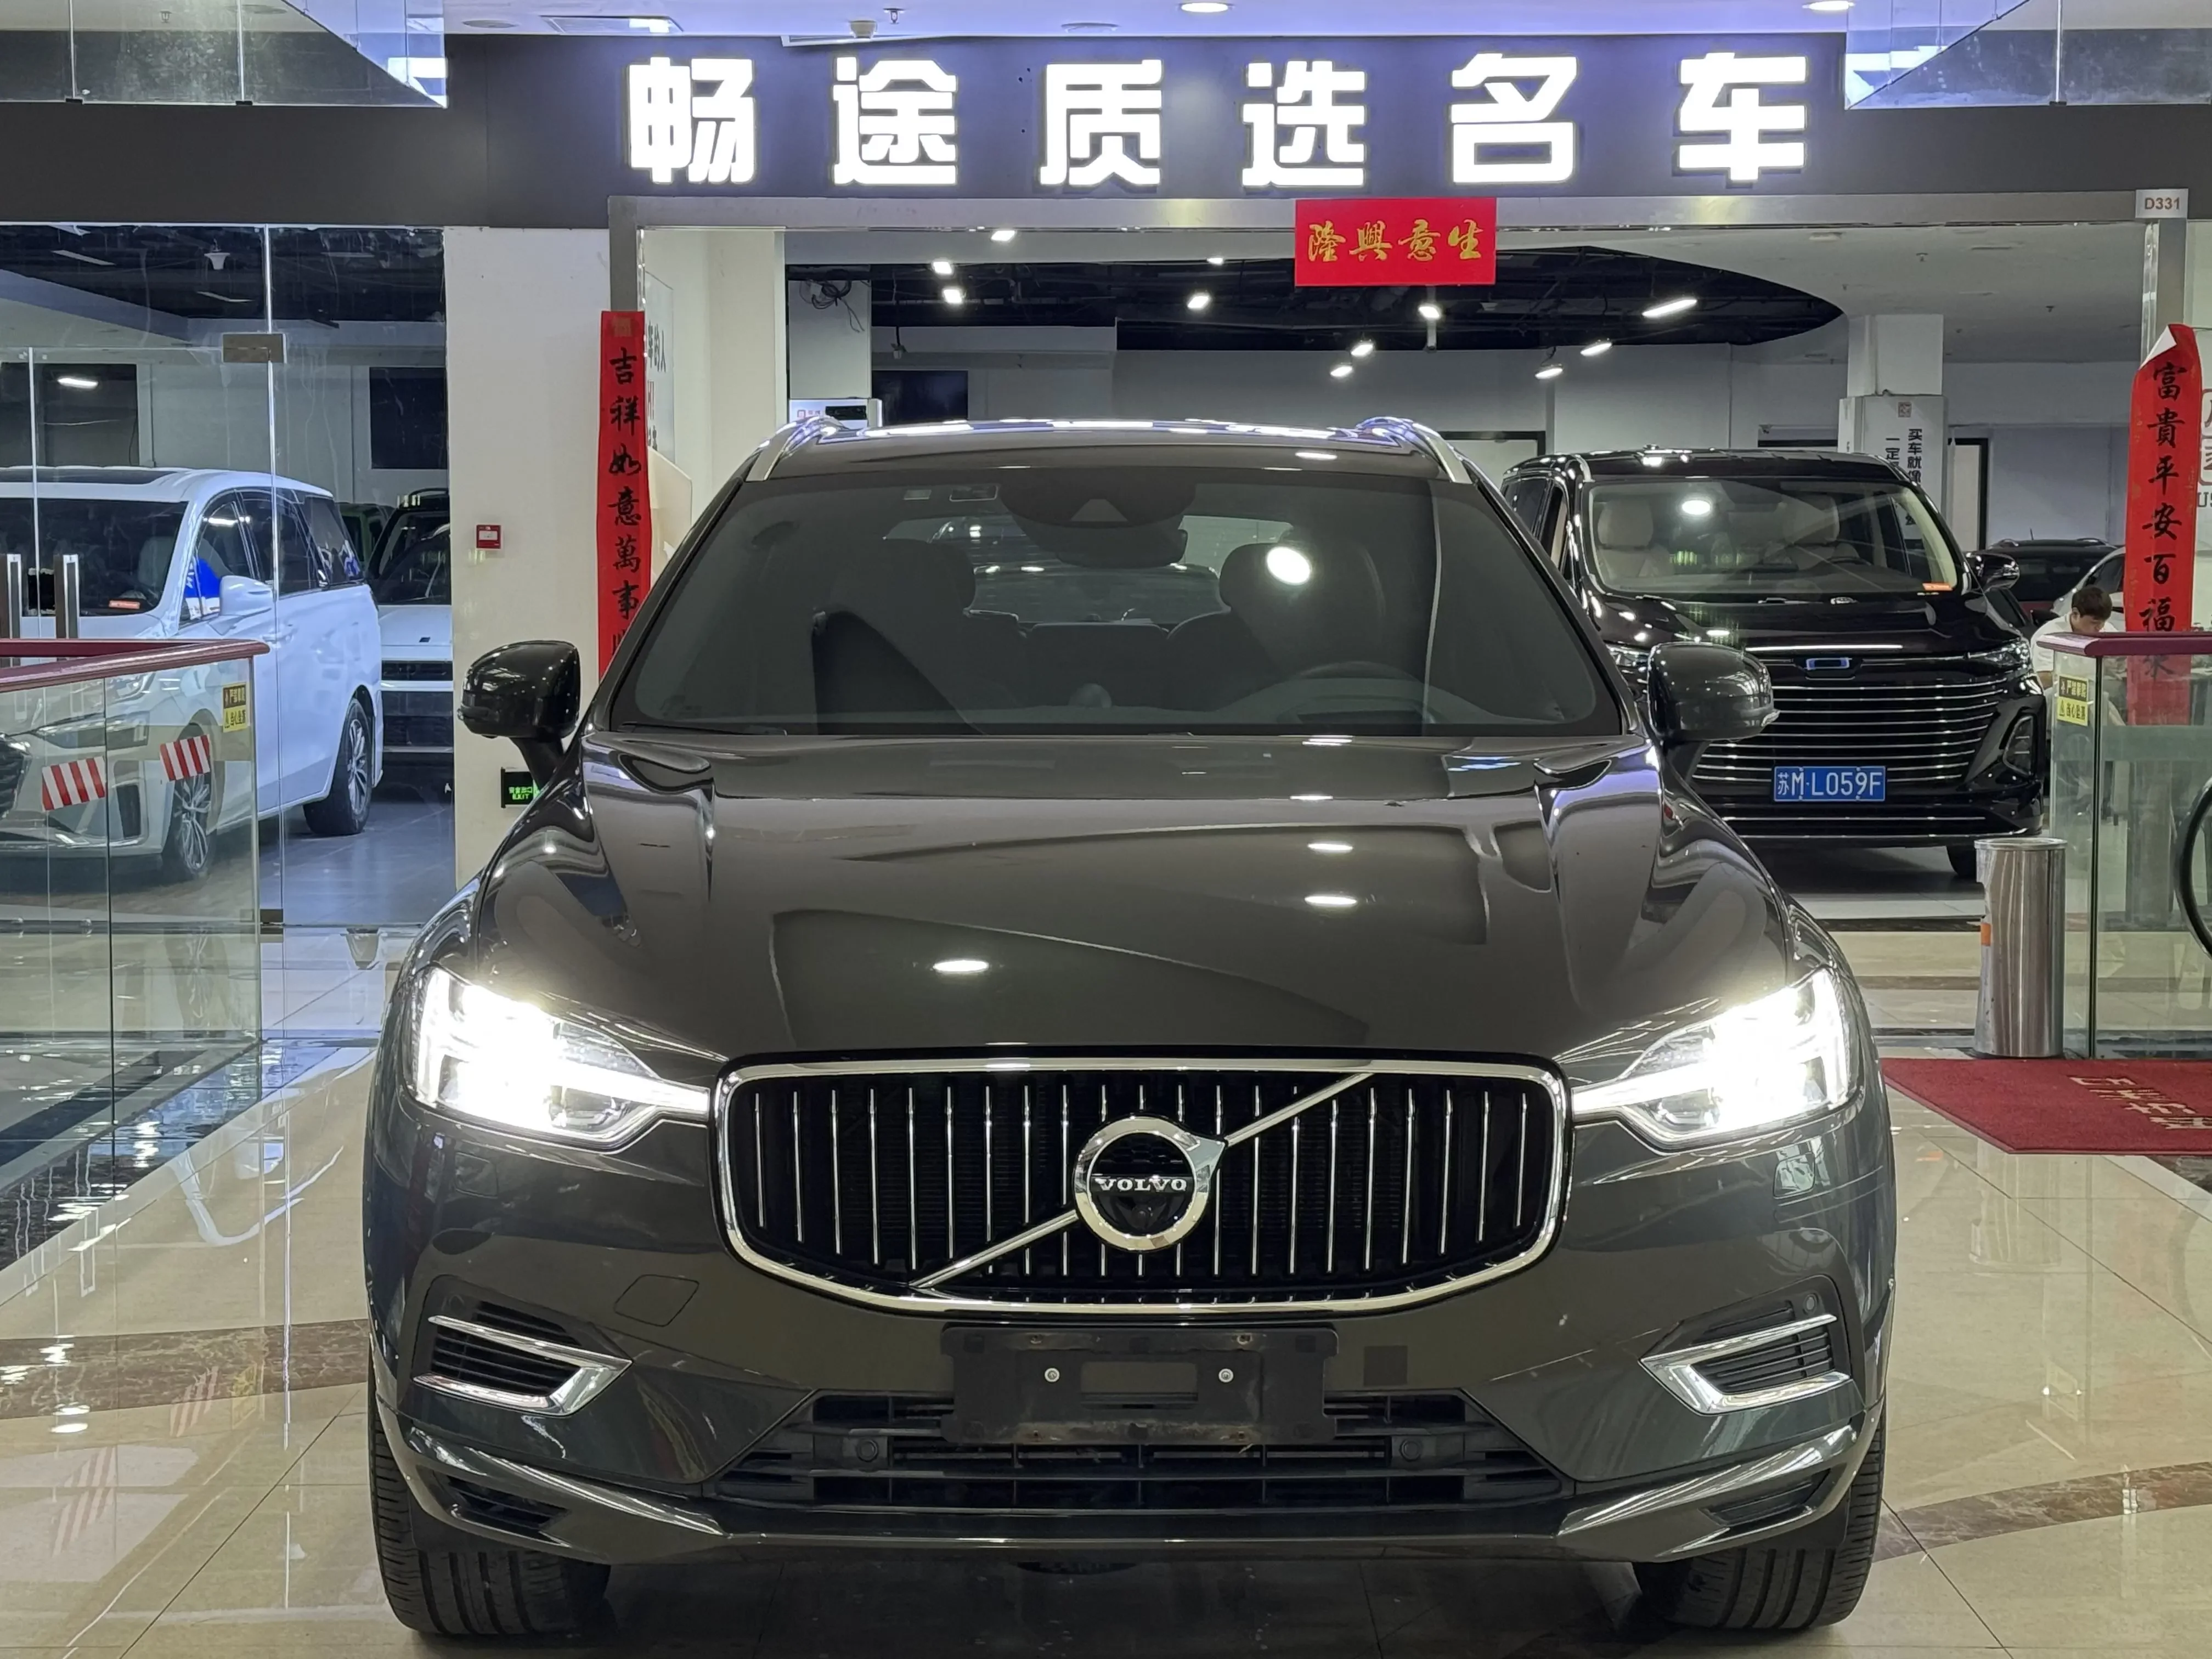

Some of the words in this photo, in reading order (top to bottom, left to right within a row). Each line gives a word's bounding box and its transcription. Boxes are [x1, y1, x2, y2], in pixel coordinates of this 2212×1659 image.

[627, 52, 1809, 185] 畅途质选名车
[2145, 197, 2180, 210] D331
[1094, 1176, 1187, 1192] VOLVO
